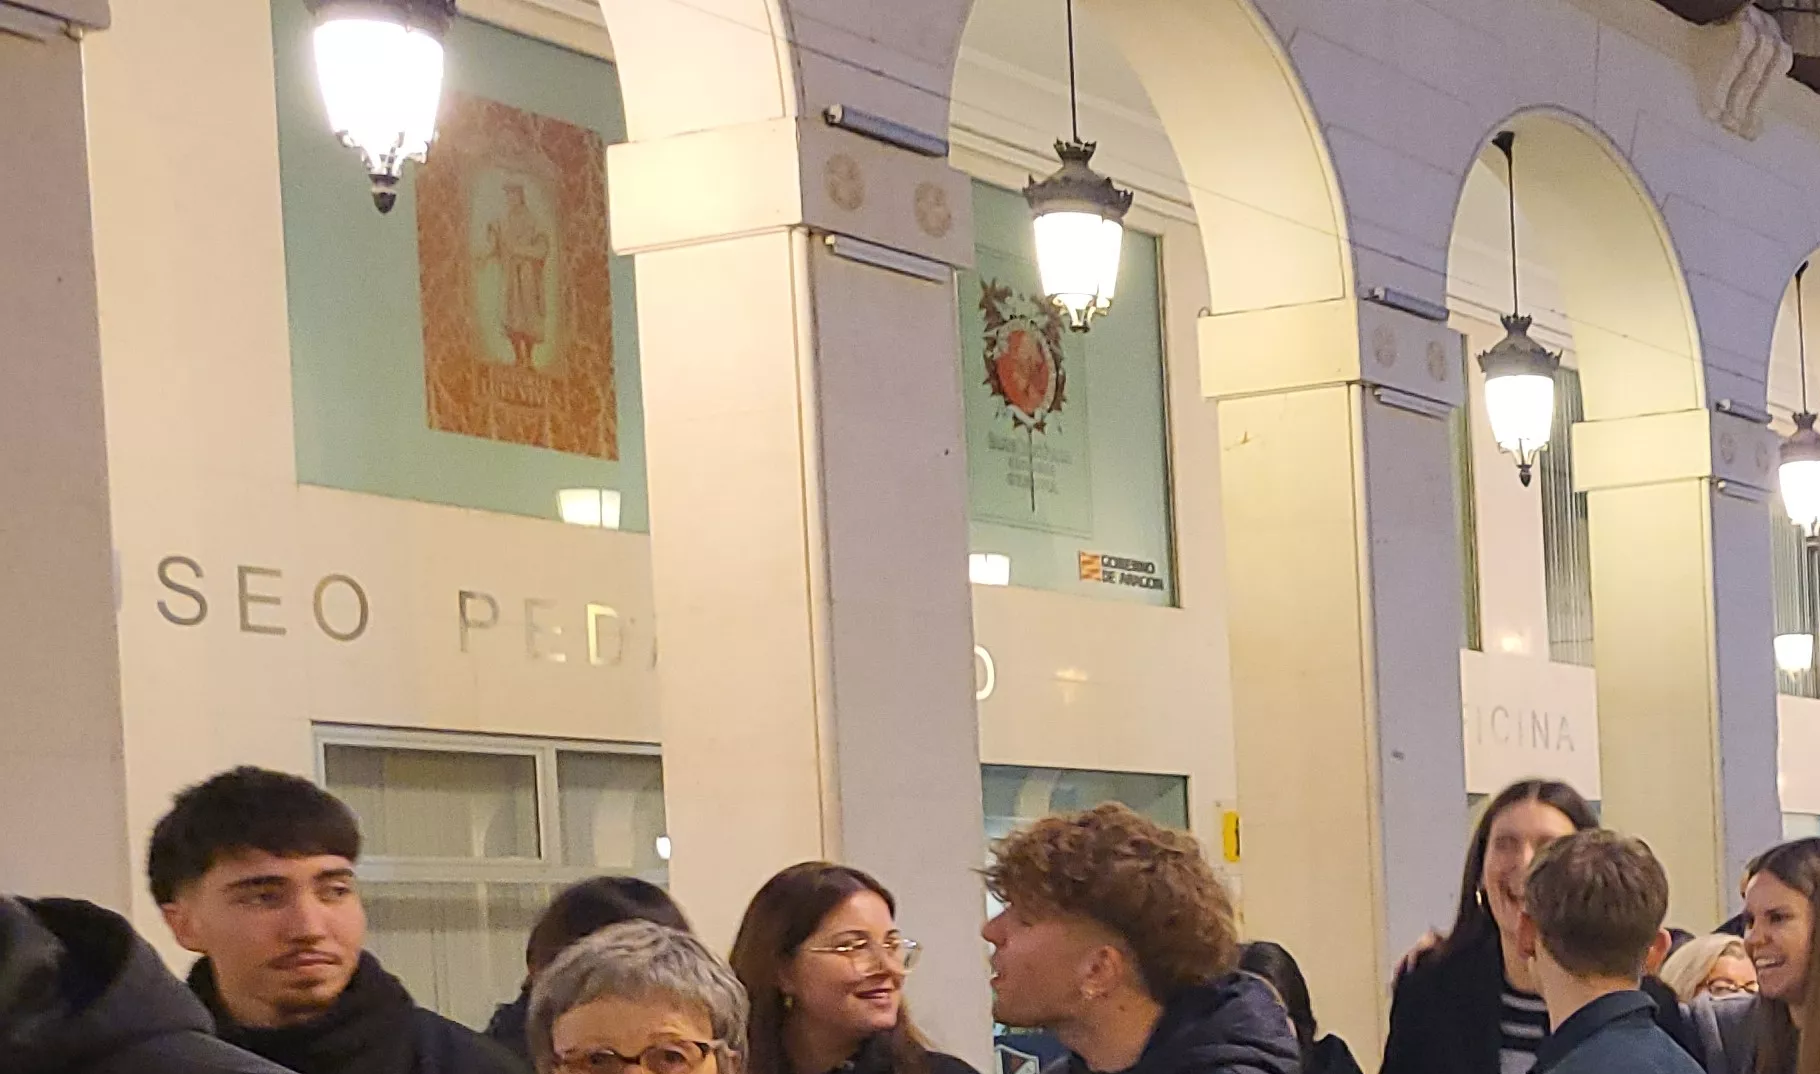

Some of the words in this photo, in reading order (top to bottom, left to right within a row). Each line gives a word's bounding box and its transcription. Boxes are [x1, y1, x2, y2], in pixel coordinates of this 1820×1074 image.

[157, 556, 369, 642] SEO
[459, 590, 657, 668] PED
[1464, 704, 1575, 752] ICINA
